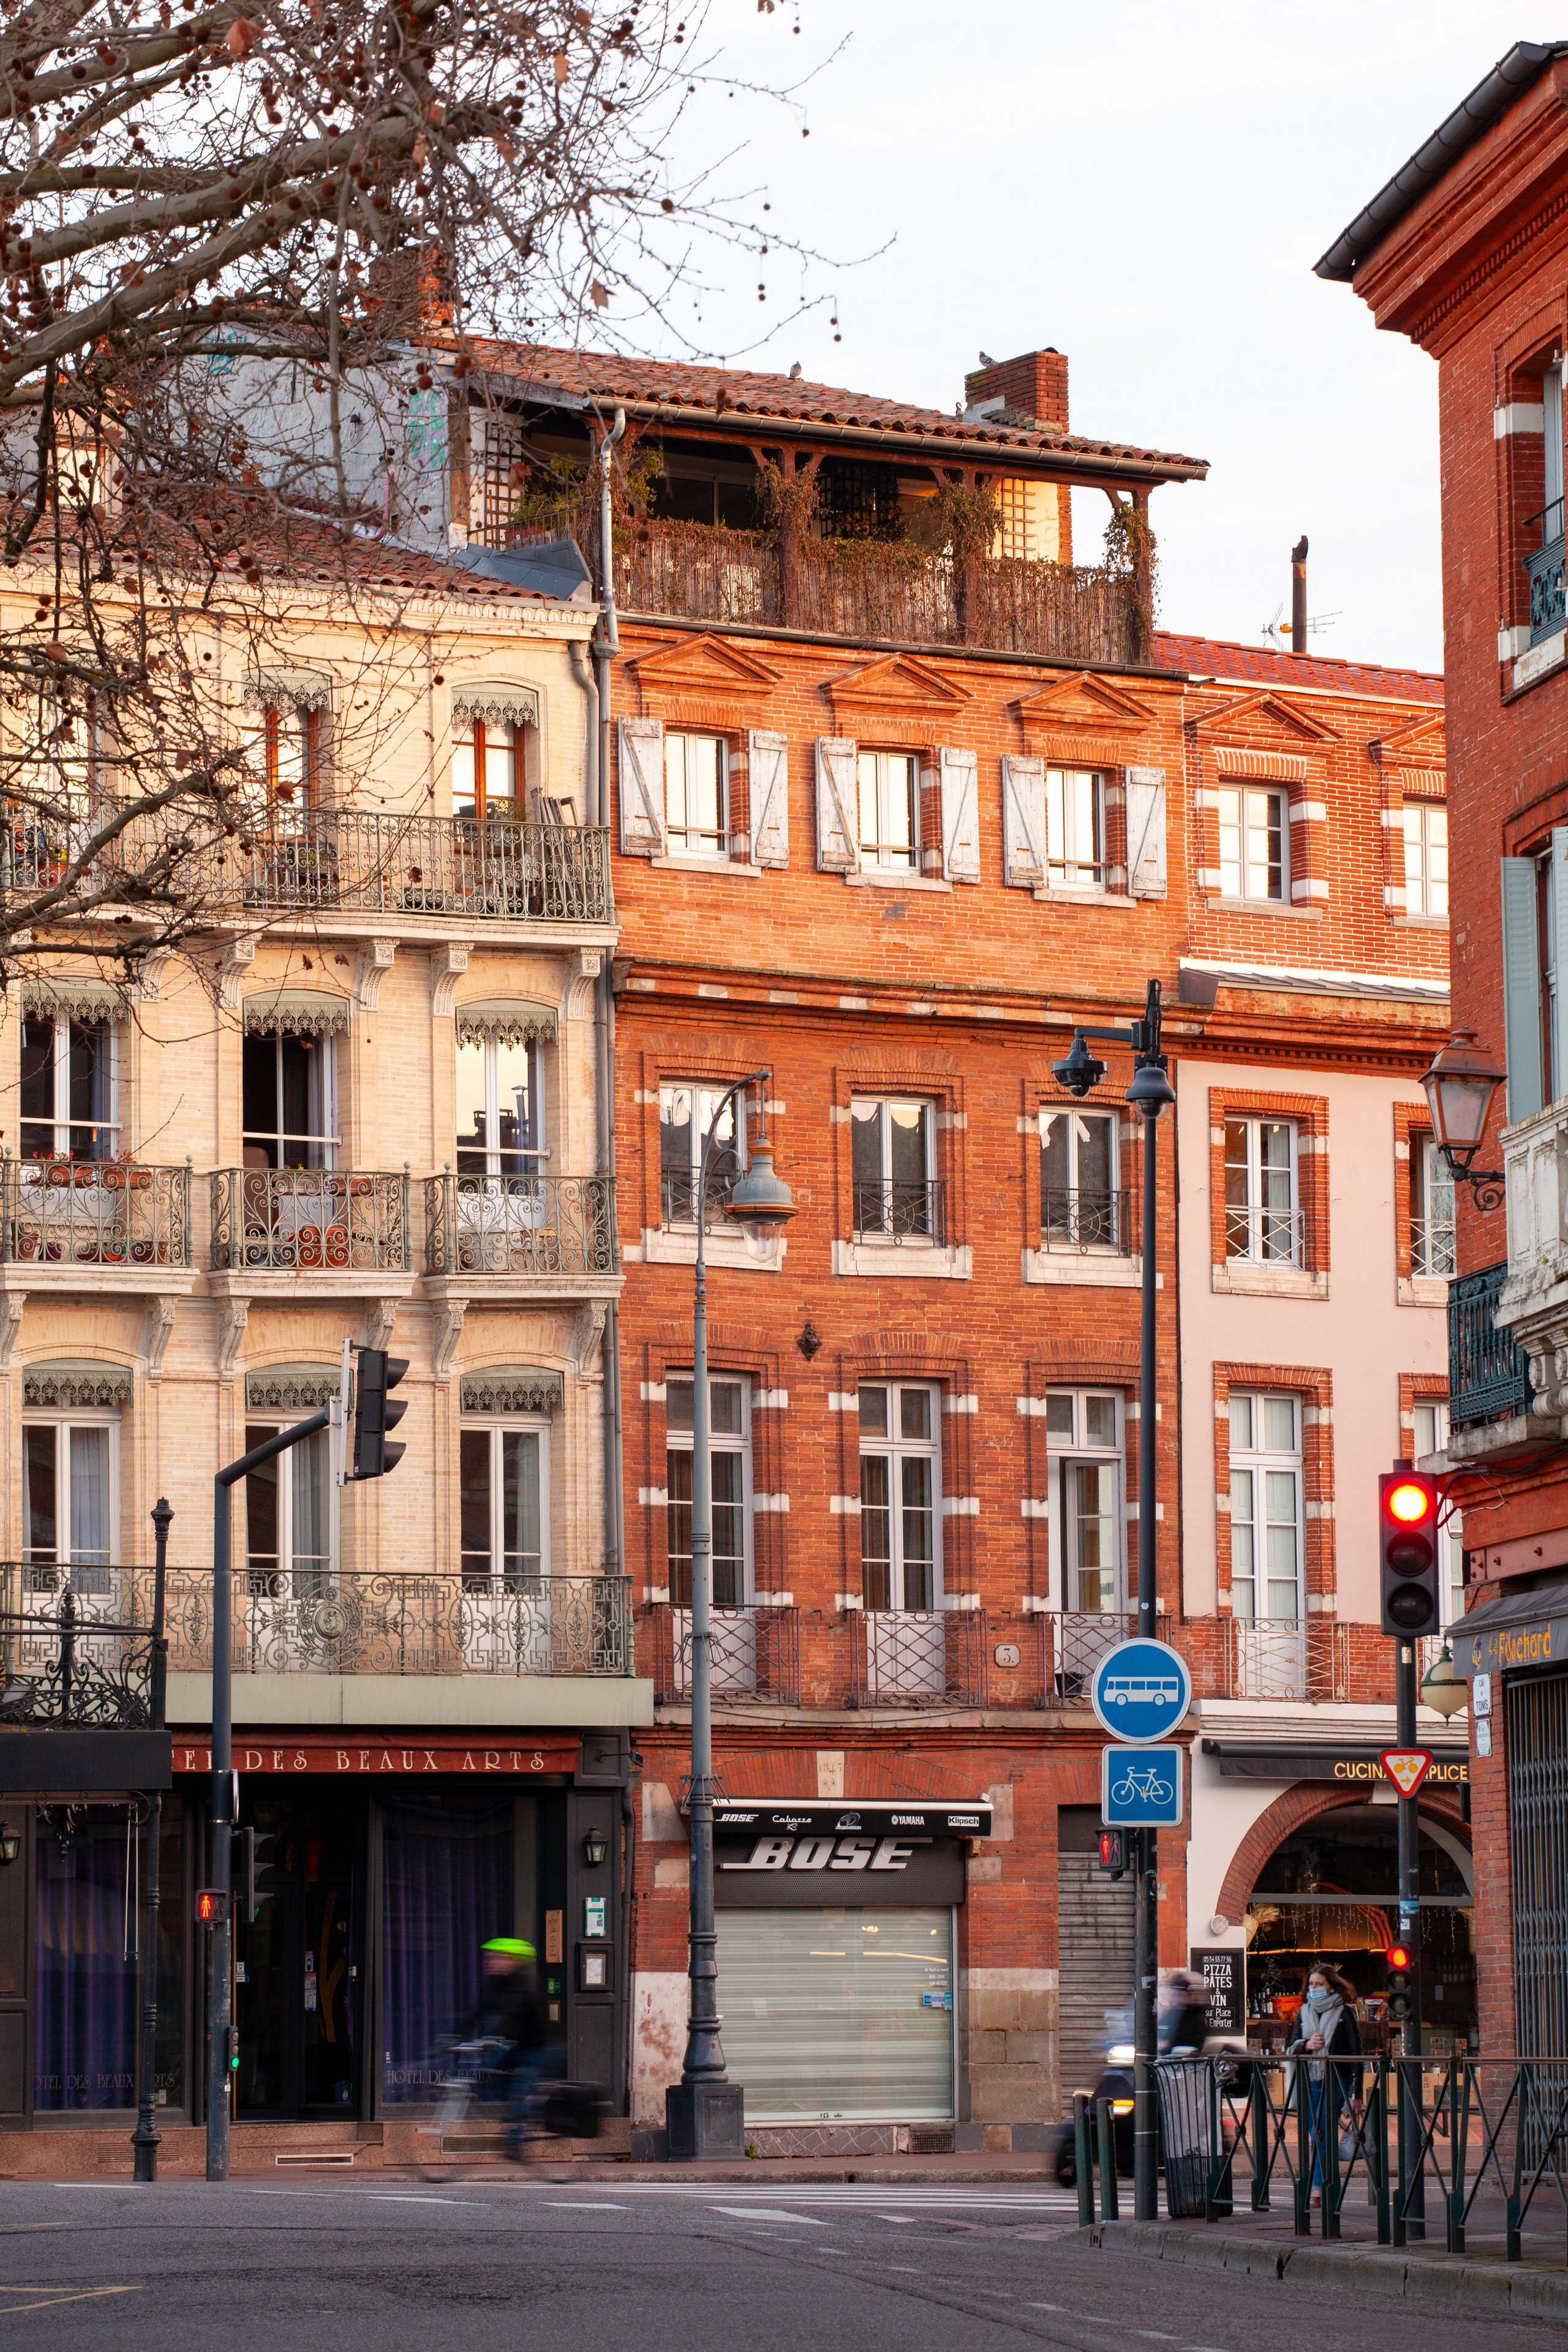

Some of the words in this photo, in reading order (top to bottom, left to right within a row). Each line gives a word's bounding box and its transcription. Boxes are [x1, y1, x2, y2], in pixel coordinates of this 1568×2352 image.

[245, 1750, 307, 1770] DES
[336, 1750, 439, 1770] BEAUX
[462, 1751, 545, 1771] ARTS
[1334, 1762, 1387, 1779] CUCIN
[1425, 1765, 1468, 1781] PLICE
[715, 1814, 759, 1822] BOSE
[899, 1815, 925, 1825] YAMAHA
[949, 1817, 979, 1825] Klipsch
[720, 1837, 933, 1869] BOSE
[1204, 1964, 1232, 1975] PIZZA
[1204, 1976, 1232, 1988] PÂTES
[1210, 1995, 1226, 2006] VIN
[67, 2075, 91, 2089] DES
[97, 2073, 135, 2088] BEAUX
[387, 2070, 424, 2084] HOTEL
[429, 2070, 451, 2084] DES
